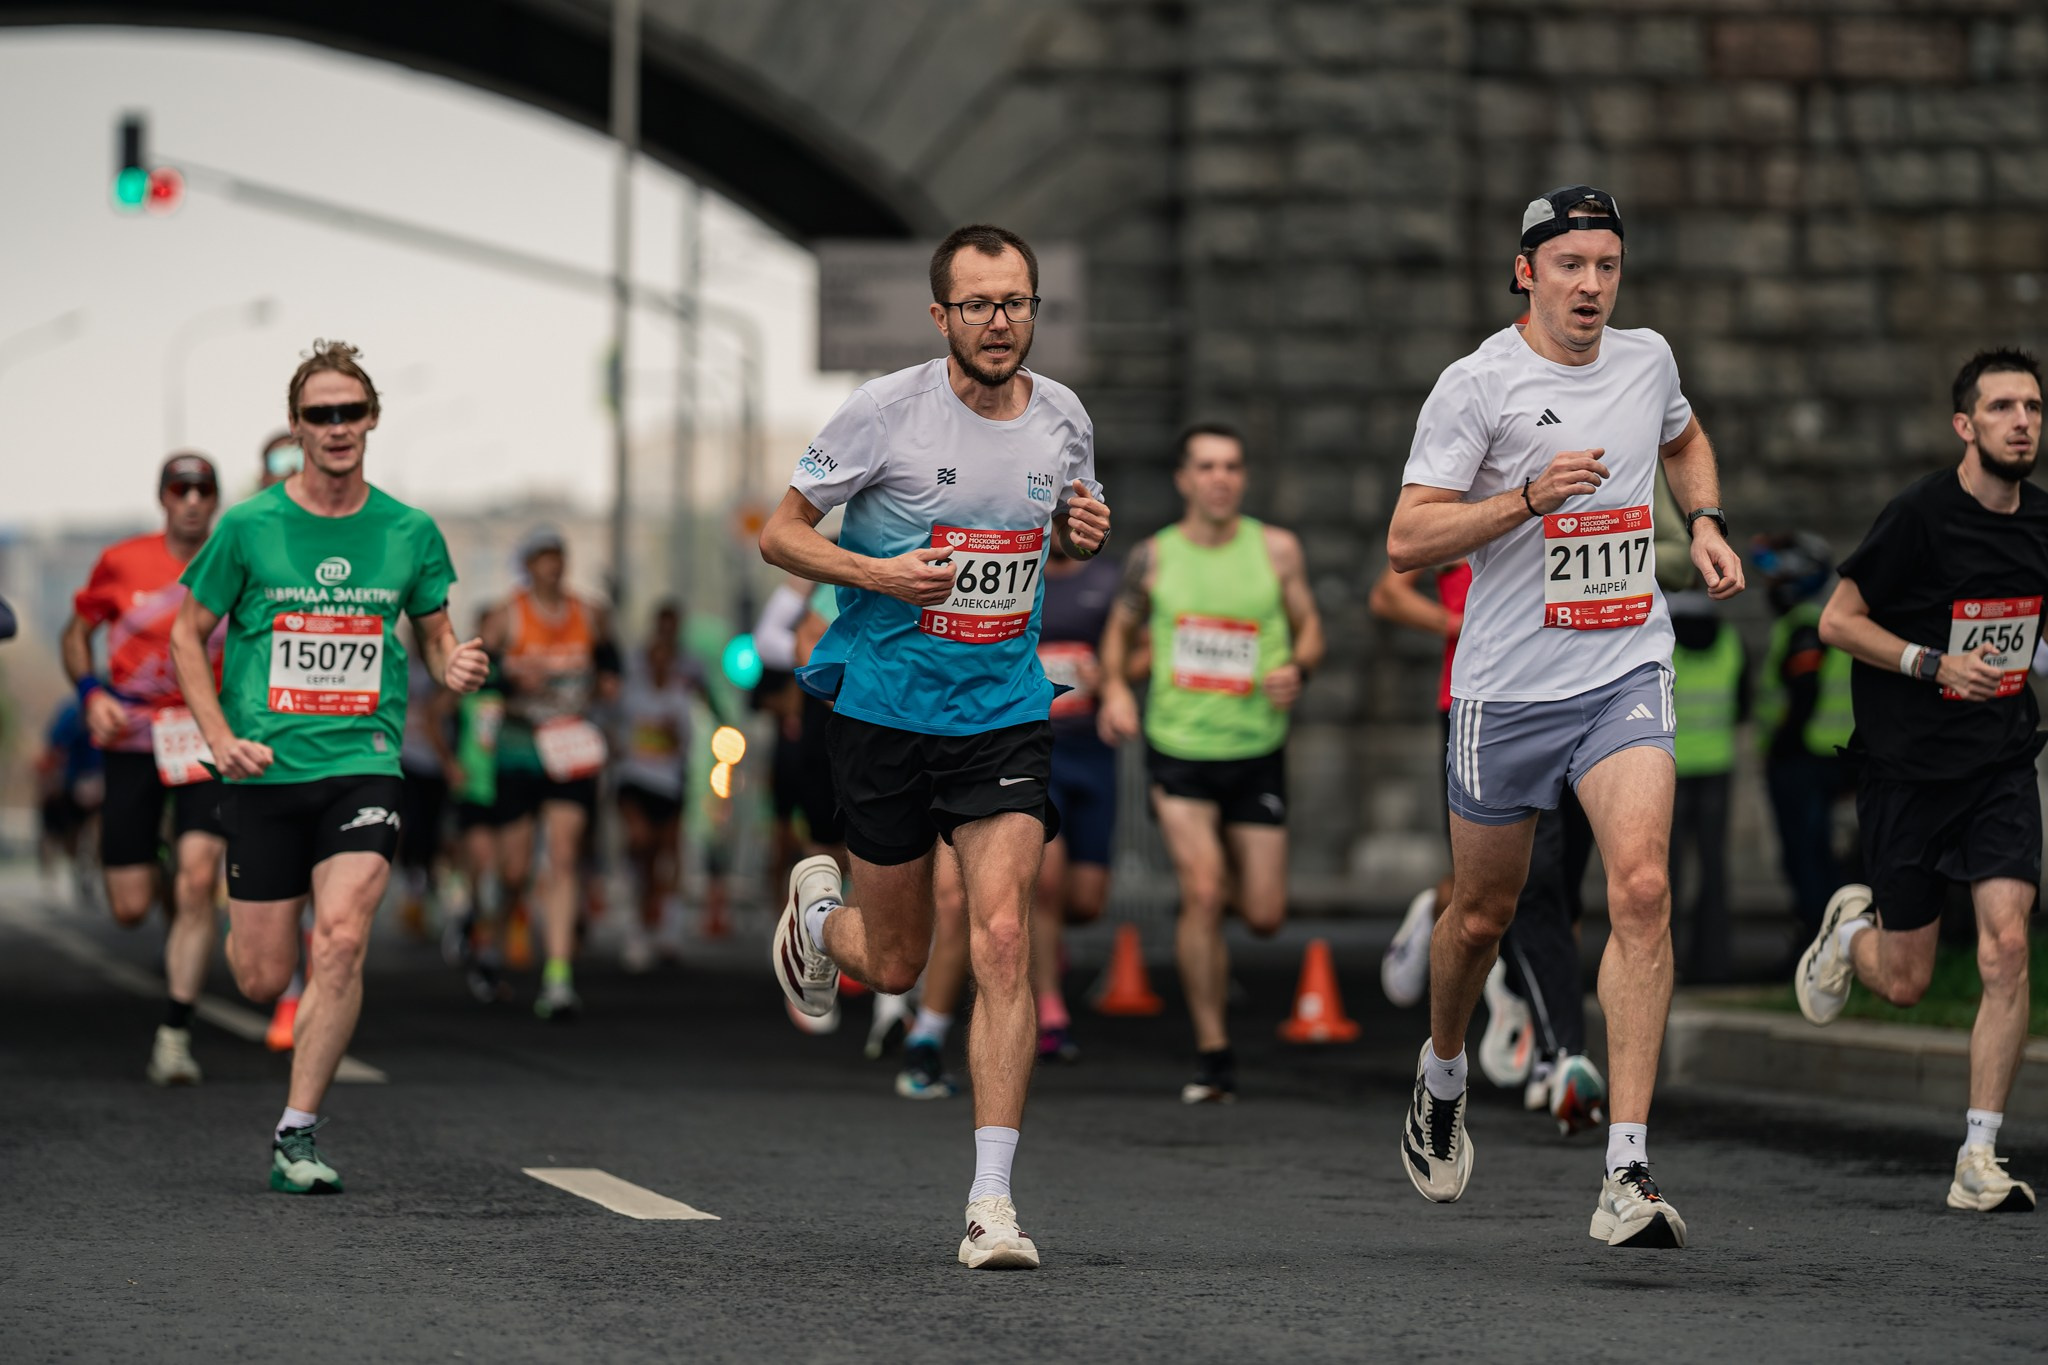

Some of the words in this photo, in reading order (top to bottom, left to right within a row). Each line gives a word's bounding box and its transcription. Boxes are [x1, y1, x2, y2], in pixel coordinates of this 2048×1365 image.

[1580, 518, 1620, 527] МОСКОВСКИЙ
[1580, 525, 1610, 533] МАРАФОН
[1550, 537, 1650, 581] 21117
[935, 557, 1039, 594] 6817
[1583, 579, 1627, 595] АНДРЕЙ
[298, 604, 366, 617] АМАРА
[952, 597, 1017, 611] АЛЕКСАНДР
[932, 614, 948, 634] B
[1556, 606, 1573, 627] B
[1962, 622, 2025, 653] 4556
[279, 640, 378, 672] 15079
[276, 690, 294, 711] A
